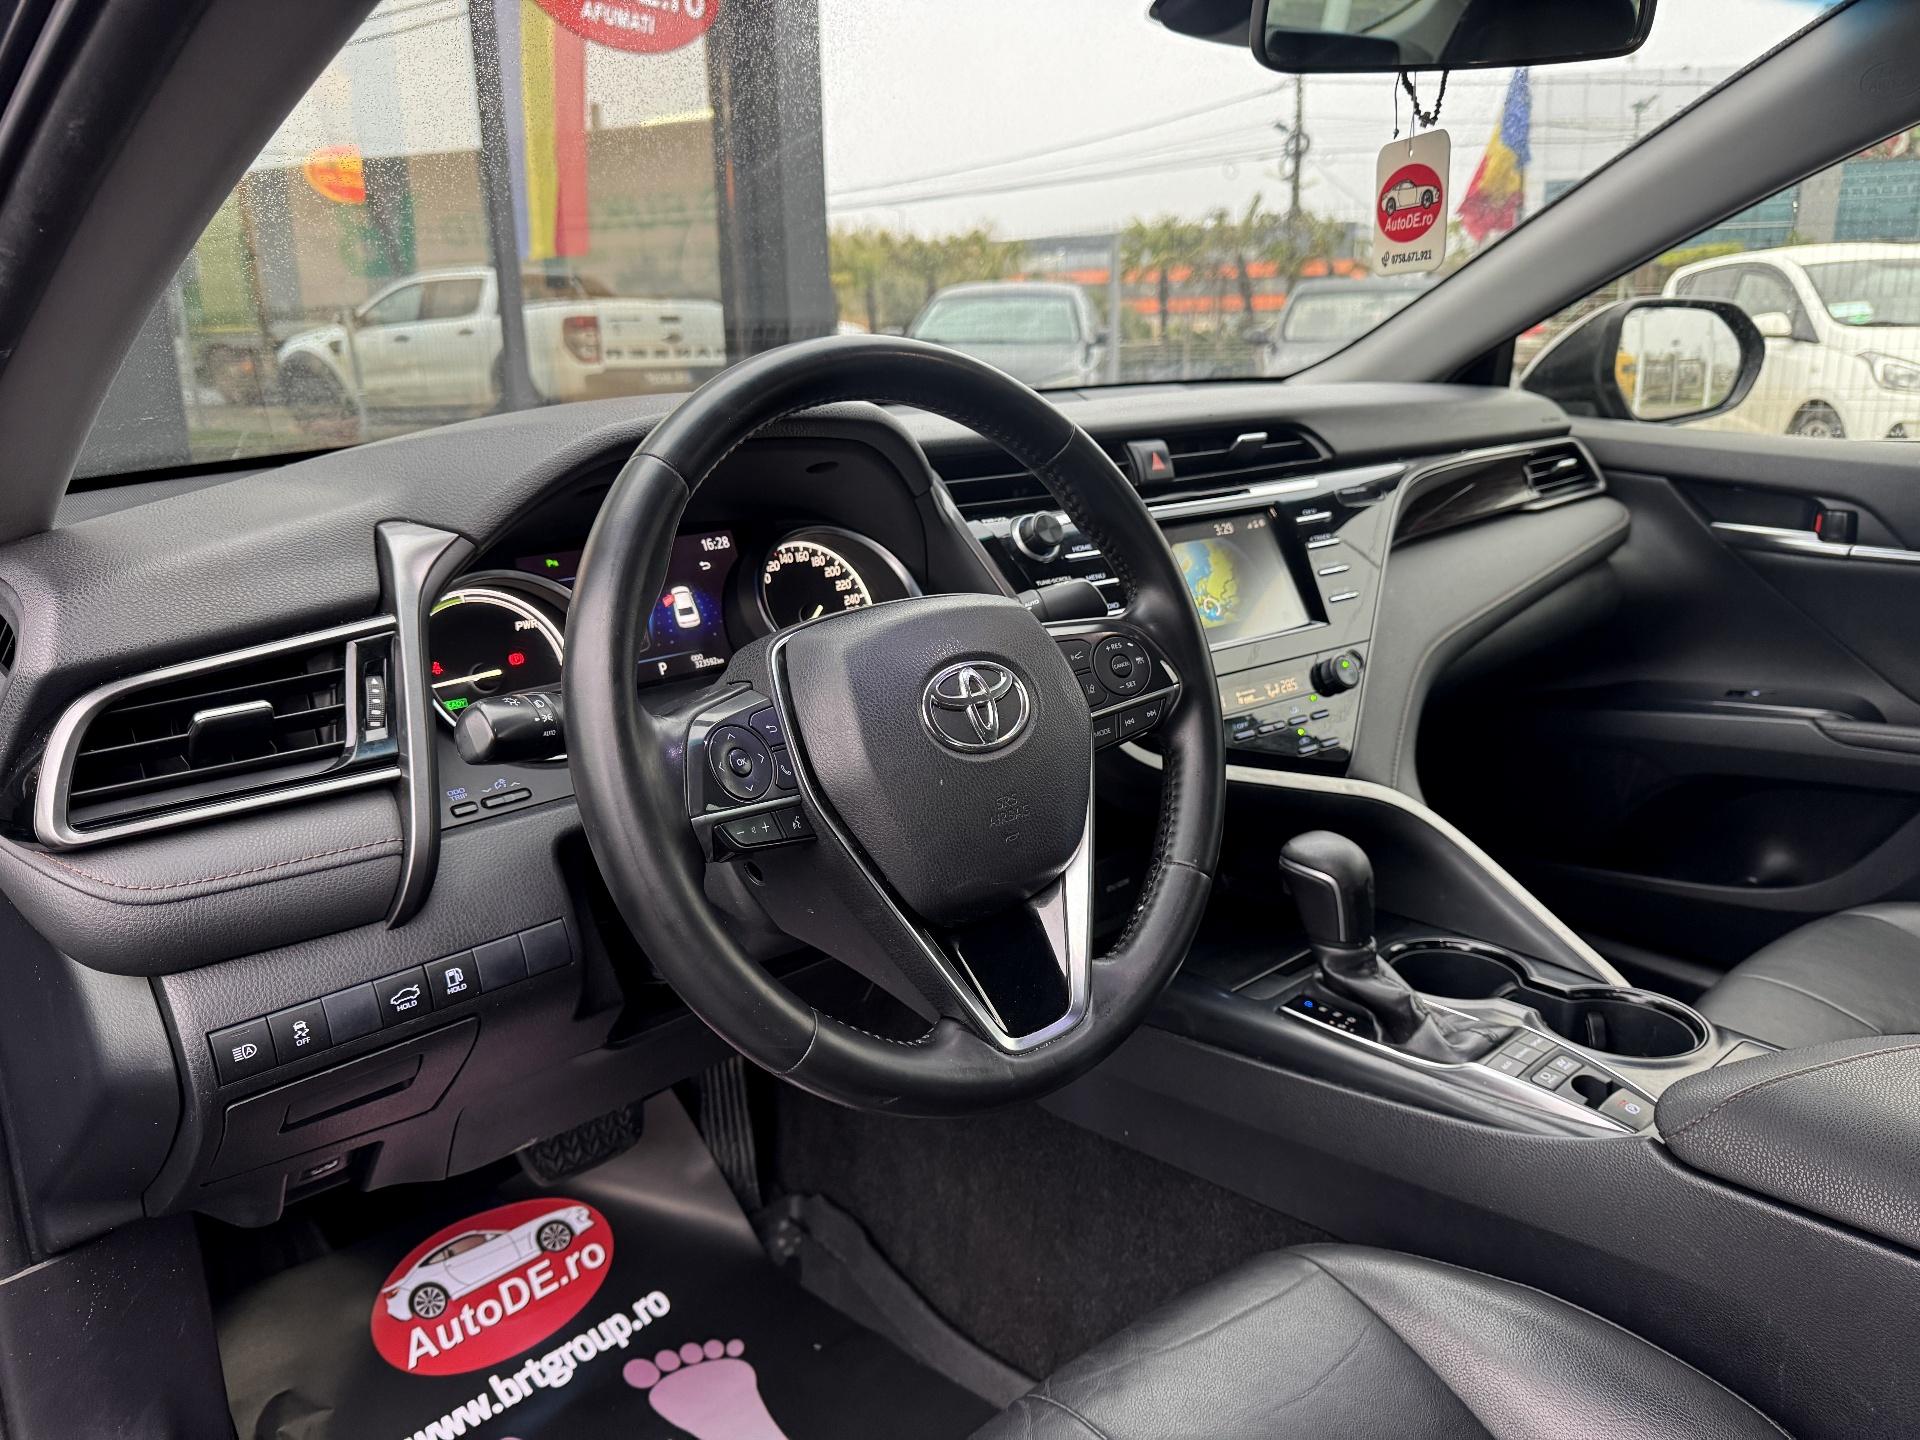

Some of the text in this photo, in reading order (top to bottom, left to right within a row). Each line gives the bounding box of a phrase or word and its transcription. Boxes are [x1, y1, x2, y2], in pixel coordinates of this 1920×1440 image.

[1384, 212, 1433, 232] AutoDE.ro
[700, 535, 730, 551] 16:28
[1071, 544, 1093, 552] HOME
[779, 552, 794, 564] 140
[824, 566, 841, 578] 200
[835, 579, 852, 591] 220
[843, 594, 861, 606] 240
[1024, 599, 1040, 608] AUTO
[514, 619, 539, 632] PWR
[658, 662, 668, 675] P
[1113, 661, 1131, 670] CANCEL
[736, 757, 747, 767] OK
[446, 787, 466, 797] ODO
[447, 983, 467, 995] HOLD
[397, 1000, 418, 1011] HOLD
[296, 1037, 311, 1047] OFF
[407, 1243, 606, 1370] AutoDE.ro
